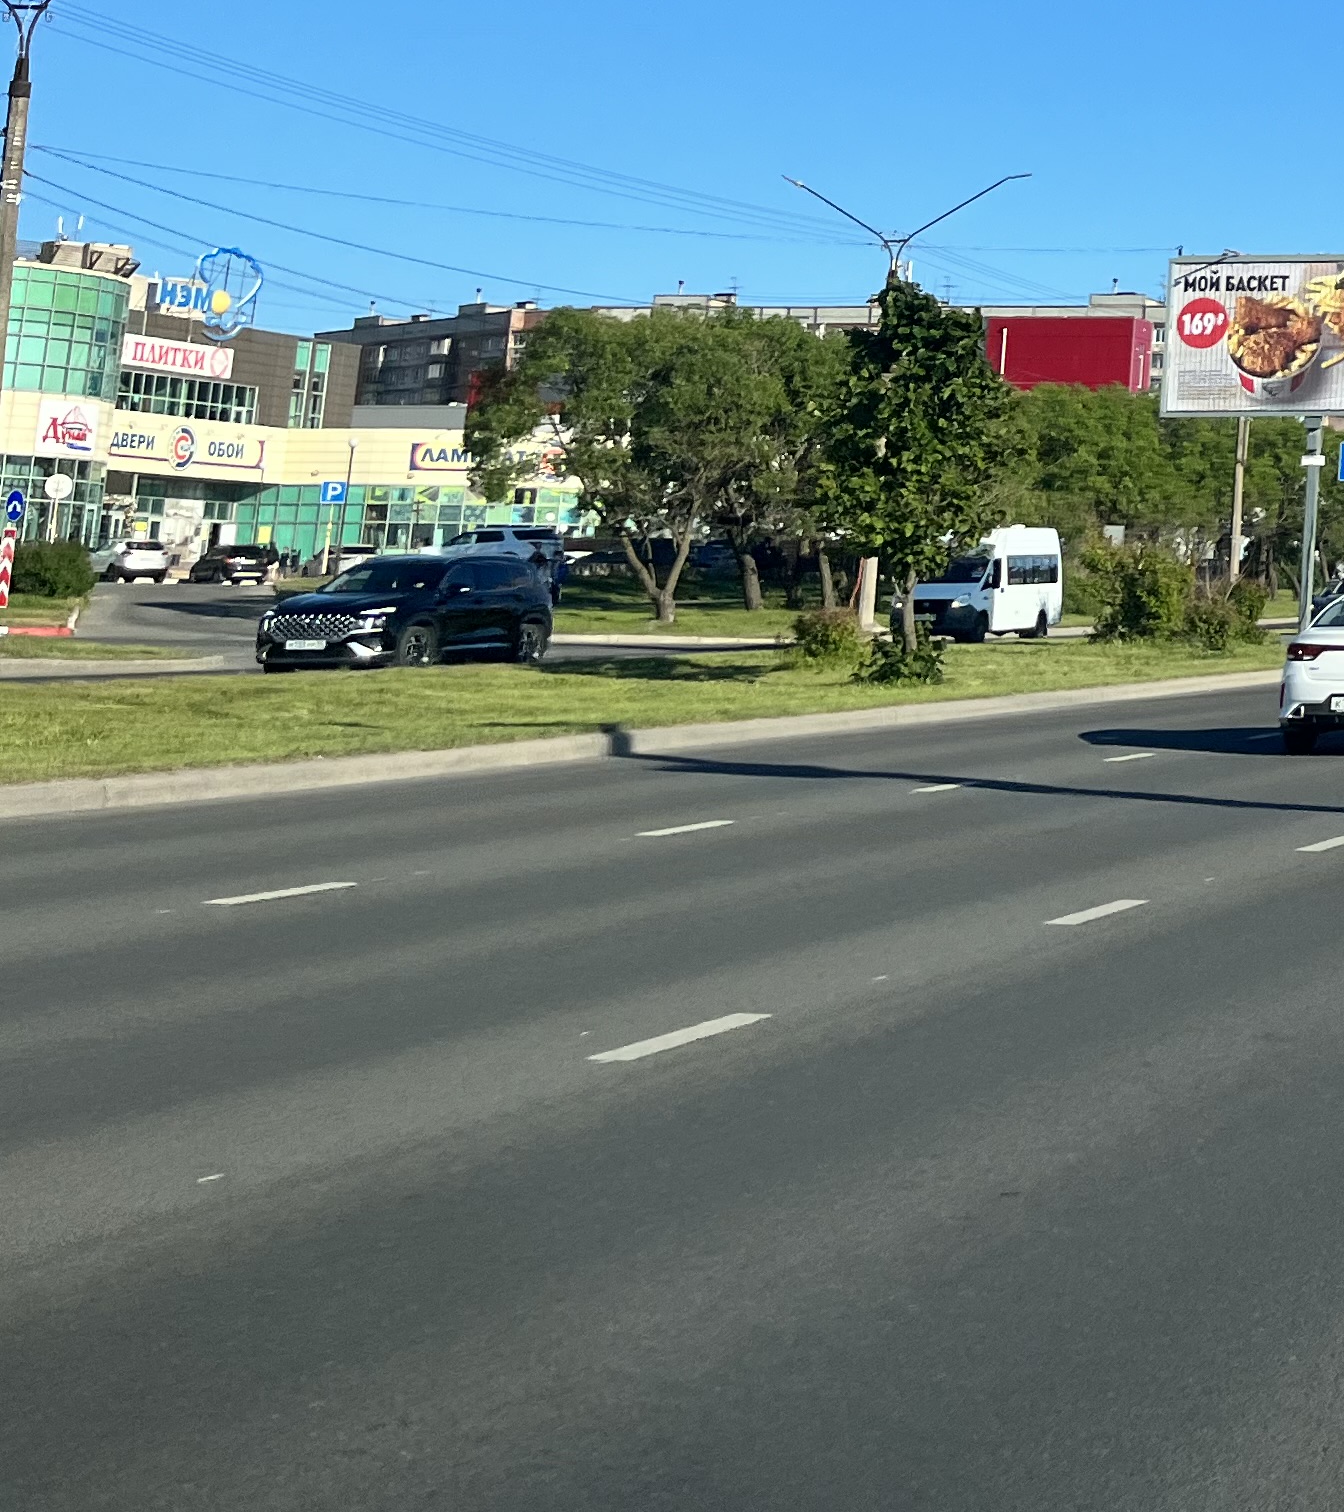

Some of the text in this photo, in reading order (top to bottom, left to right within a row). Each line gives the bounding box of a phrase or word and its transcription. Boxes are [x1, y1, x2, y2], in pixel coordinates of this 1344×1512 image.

[1184, 270, 1289, 292] МОЙ БАСКЕТ
[132, 341, 206, 370] ПЛИТКИ
[111, 431, 155, 451] ДВЕРИ
[208, 441, 244, 459] ОБОИ
